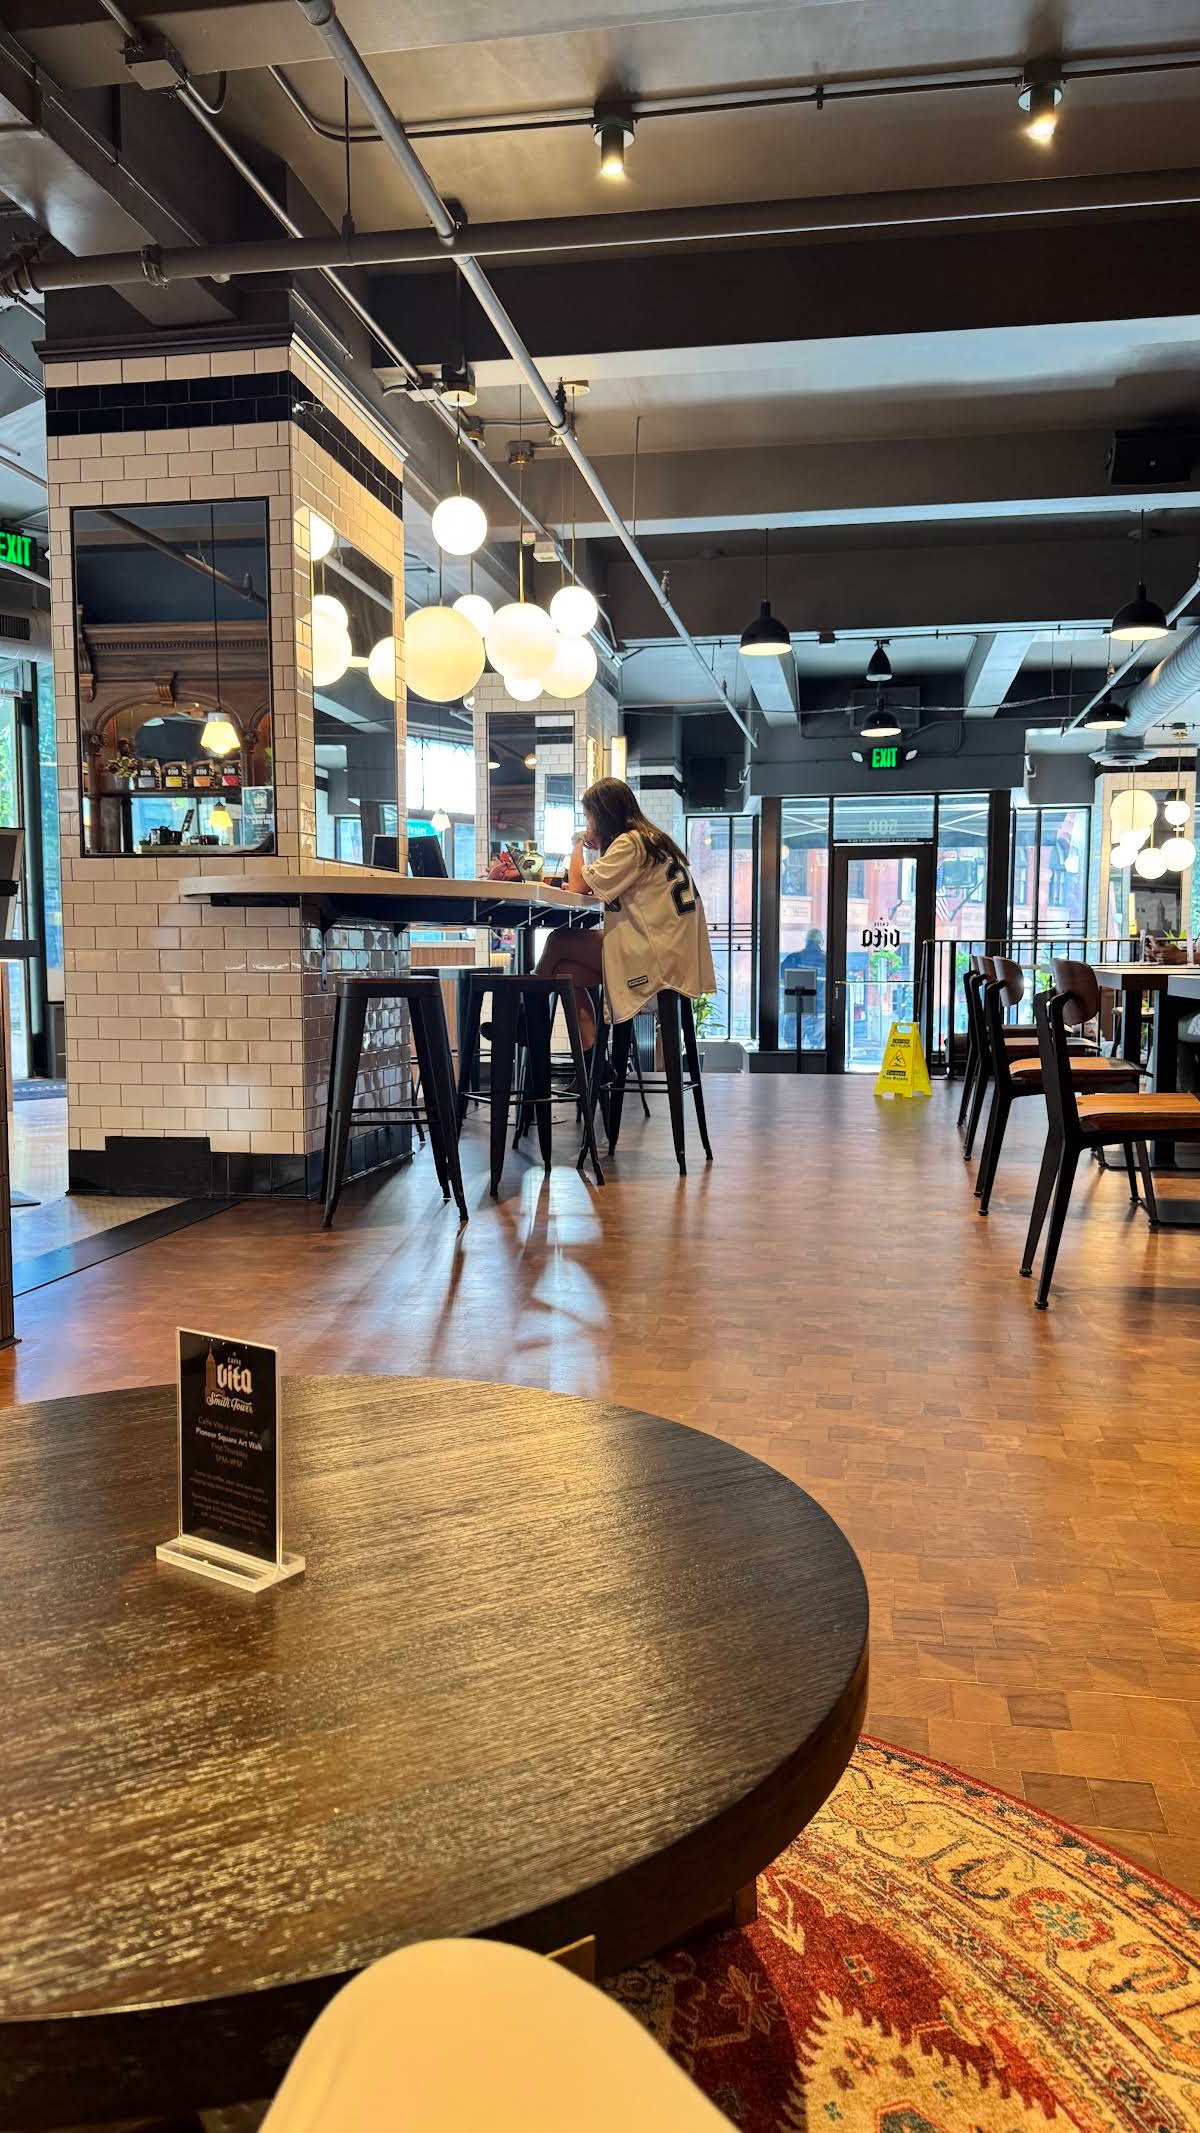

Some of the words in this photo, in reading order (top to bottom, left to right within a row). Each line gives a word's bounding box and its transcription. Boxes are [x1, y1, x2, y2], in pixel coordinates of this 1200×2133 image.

[872, 747, 898, 768] EXIT
[217, 1363, 253, 1395] vita
[206, 1391, 231, 1409] Smith
[231, 1397, 253, 1414] Tower
[195, 1426, 217, 1438] Pioneer
[217, 1432, 238, 1444] Square
[238, 1438, 248, 1447] Art
[248, 1440, 263, 1451] Walk
